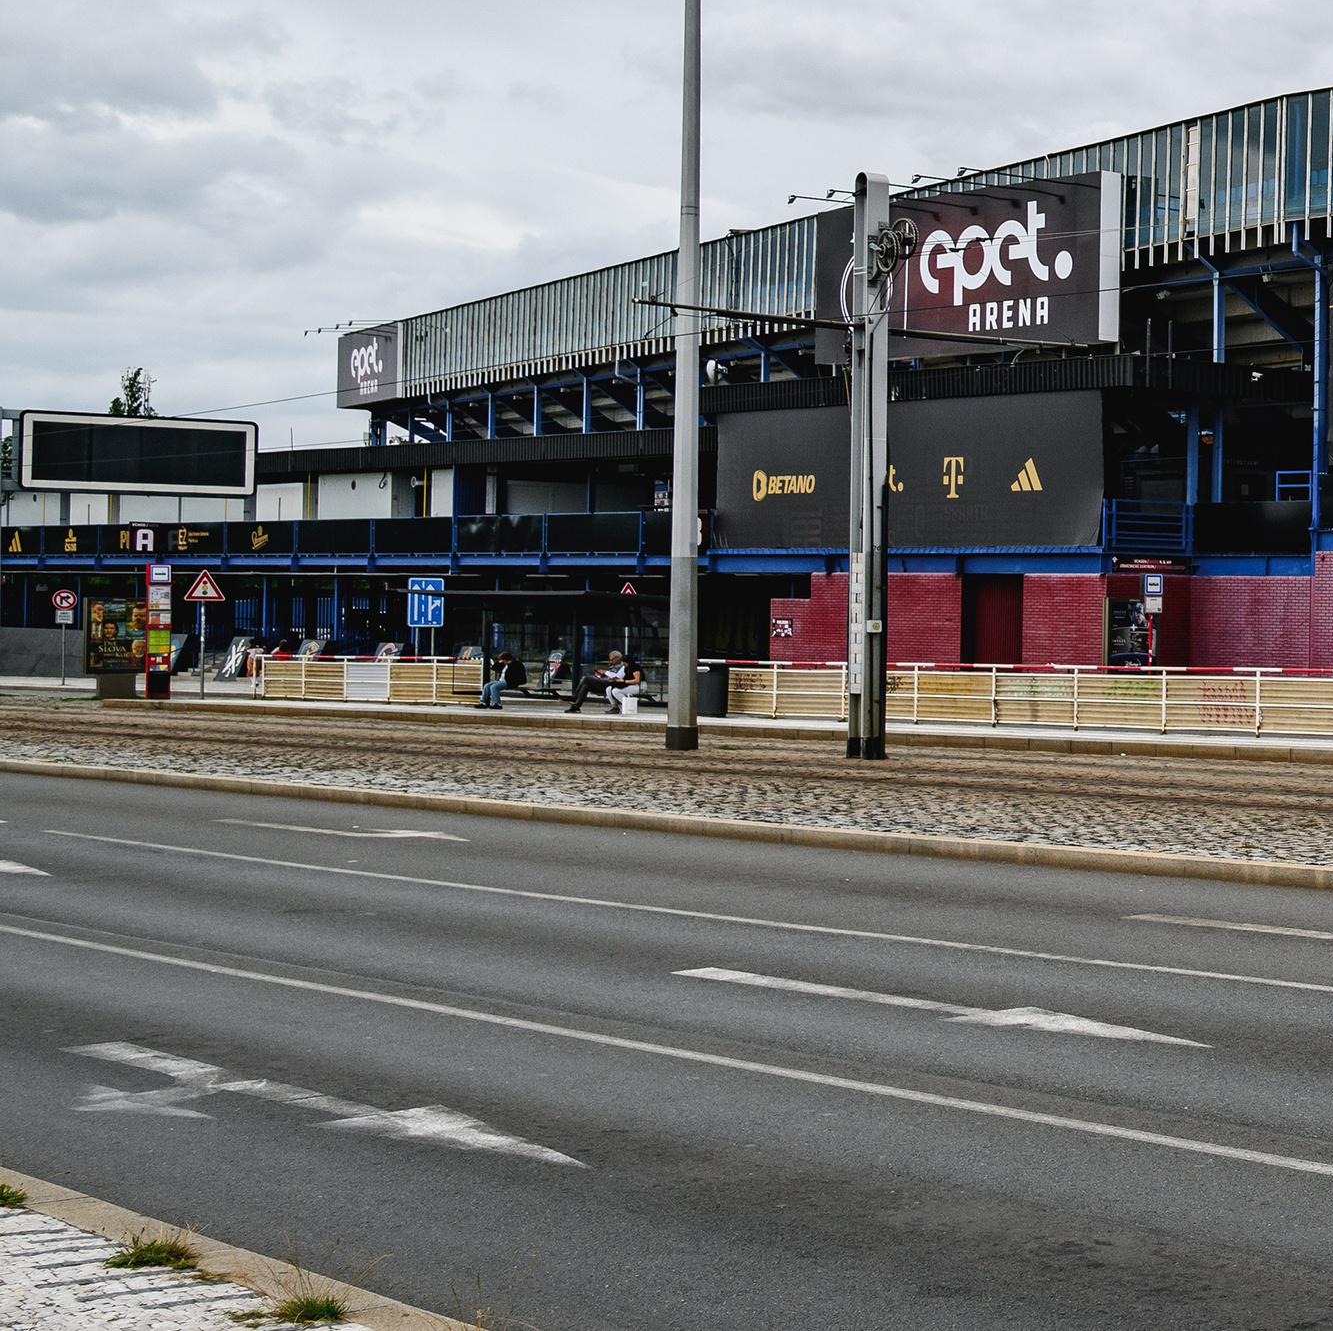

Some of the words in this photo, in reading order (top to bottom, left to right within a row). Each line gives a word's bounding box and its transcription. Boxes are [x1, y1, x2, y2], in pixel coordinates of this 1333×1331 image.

[919, 200, 1073, 306] epet.
[968, 296, 1049, 332] ARENA
[350, 336, 383, 384] epet.
[767, 474, 815, 496] BETANO
[136, 528, 154, 551] A
